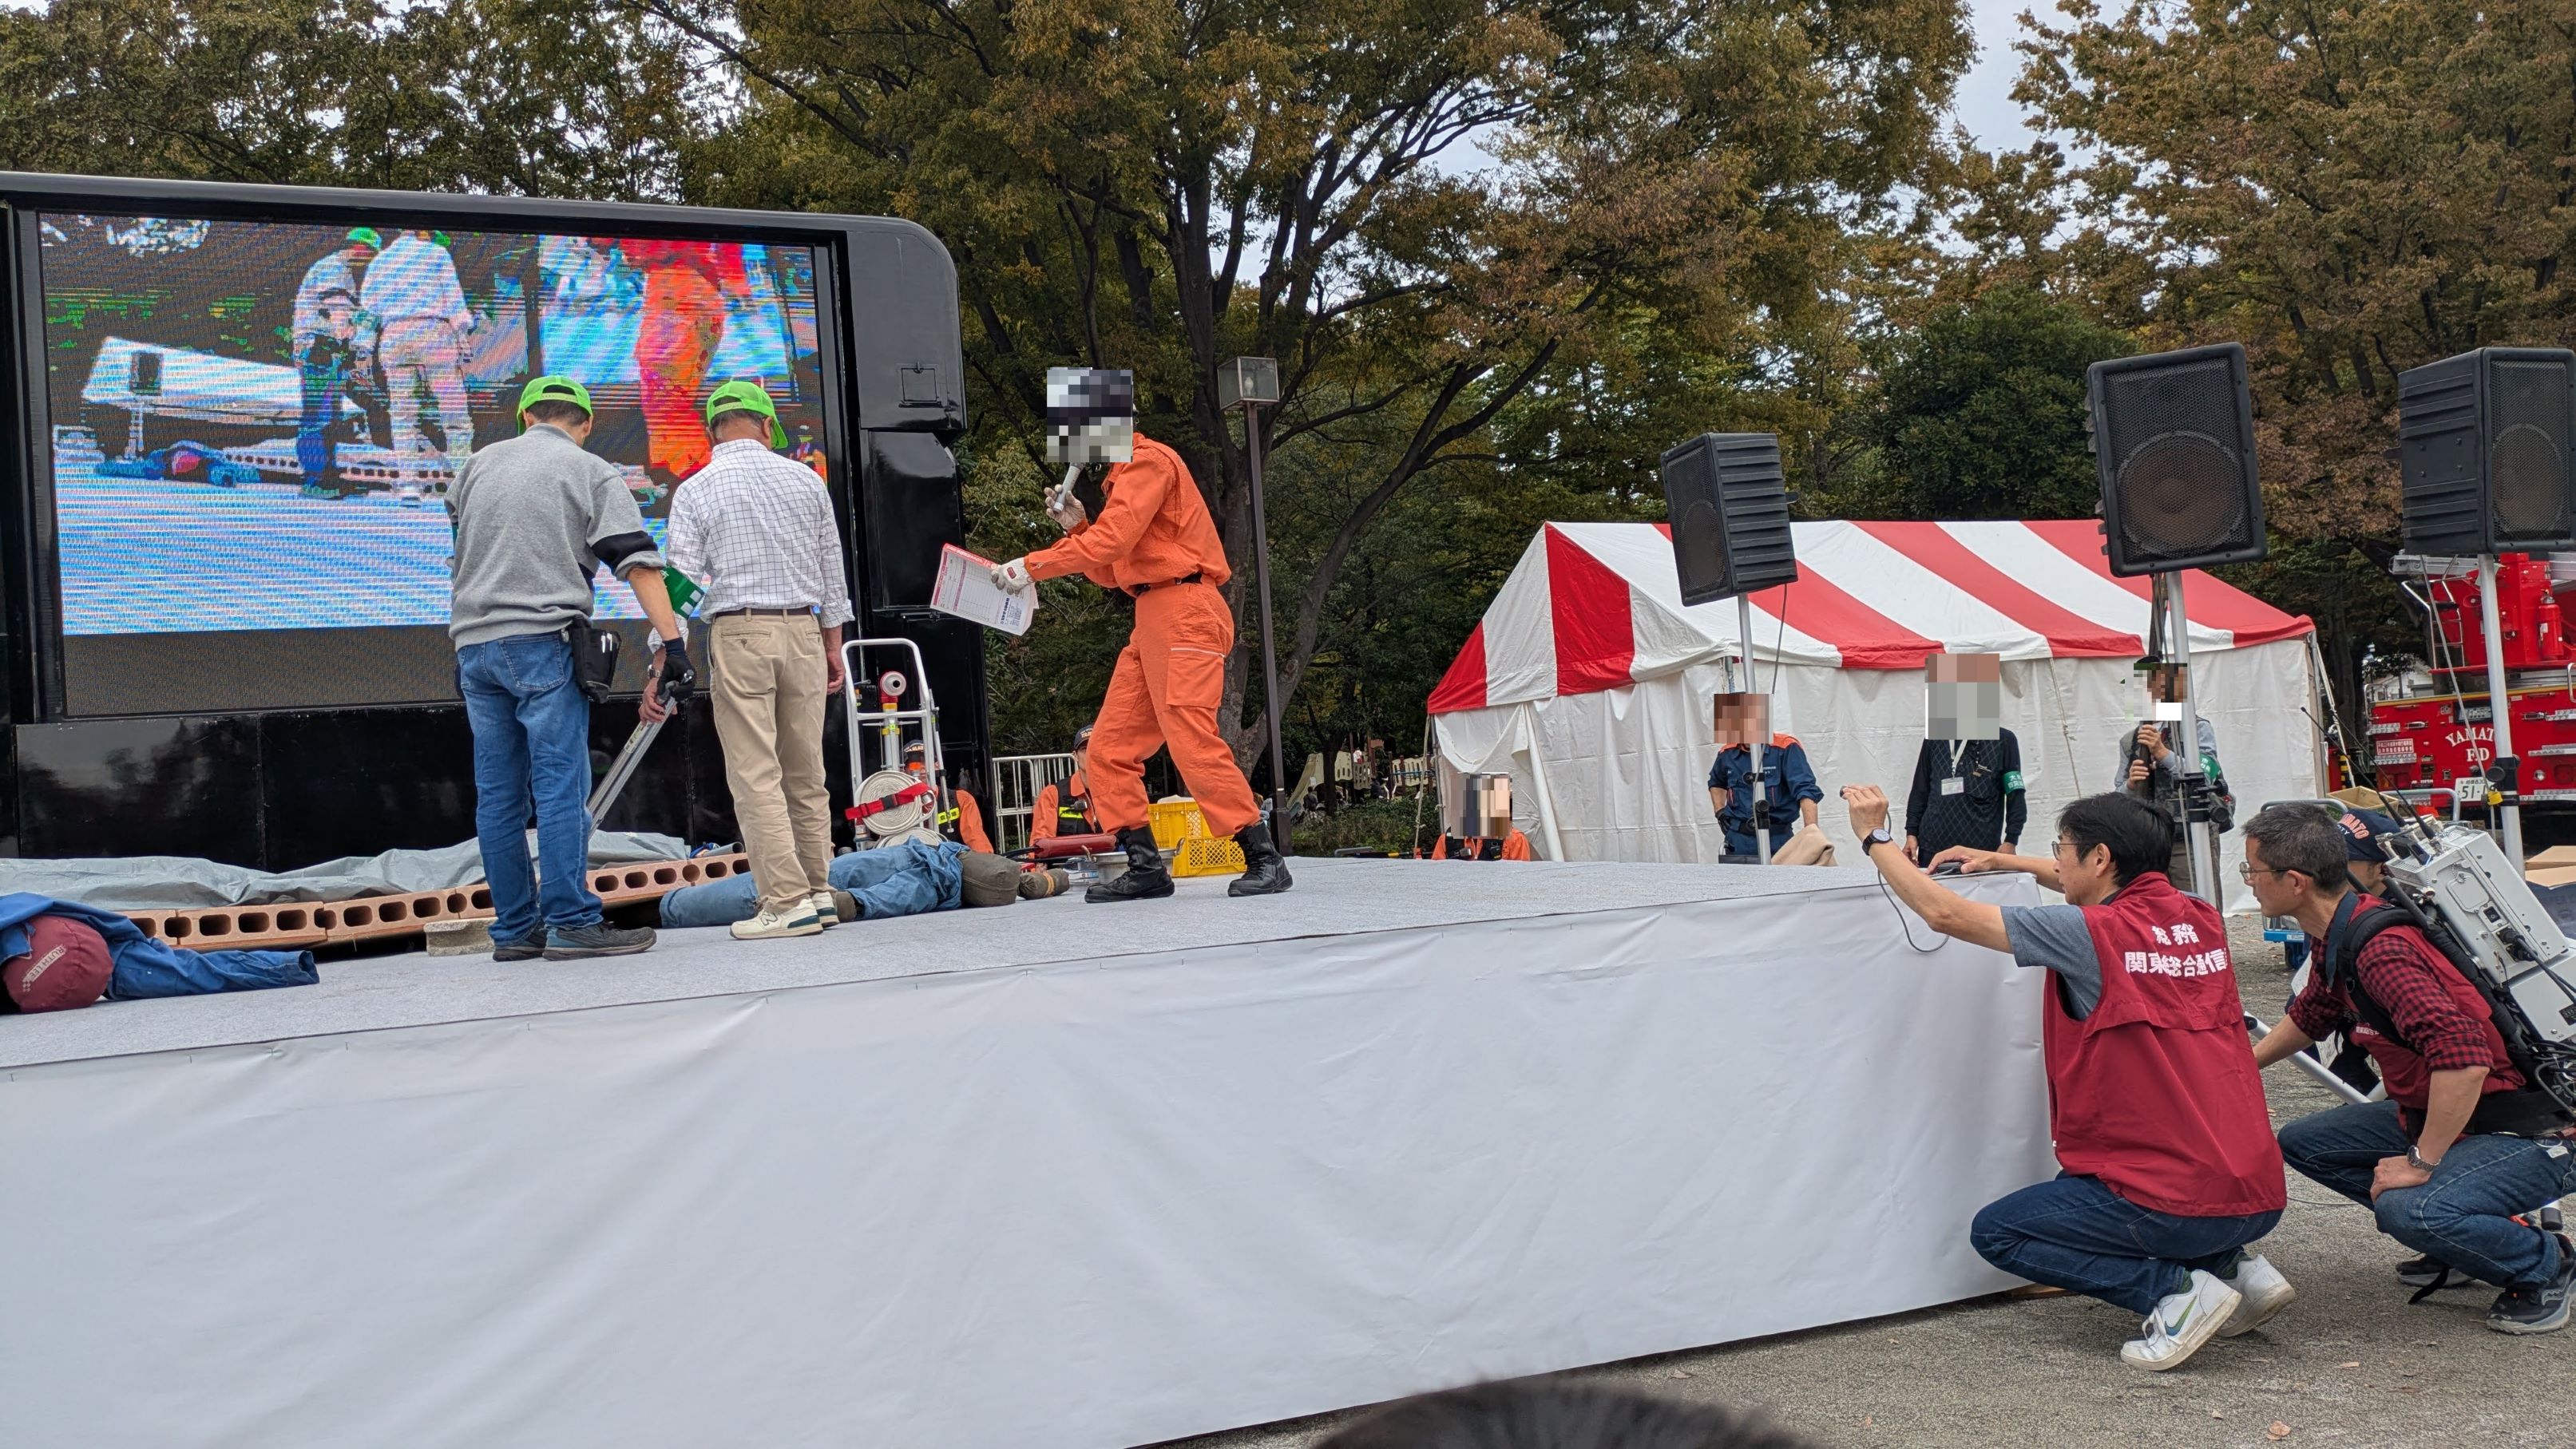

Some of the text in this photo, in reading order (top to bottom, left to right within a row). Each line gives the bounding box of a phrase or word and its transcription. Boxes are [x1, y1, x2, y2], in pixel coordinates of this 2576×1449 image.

[2445, 727, 2495, 747] YAMAT
[30, 946, 64, 977] RUTH LEE
[2125, 948, 2228, 977] 関東総合通信
